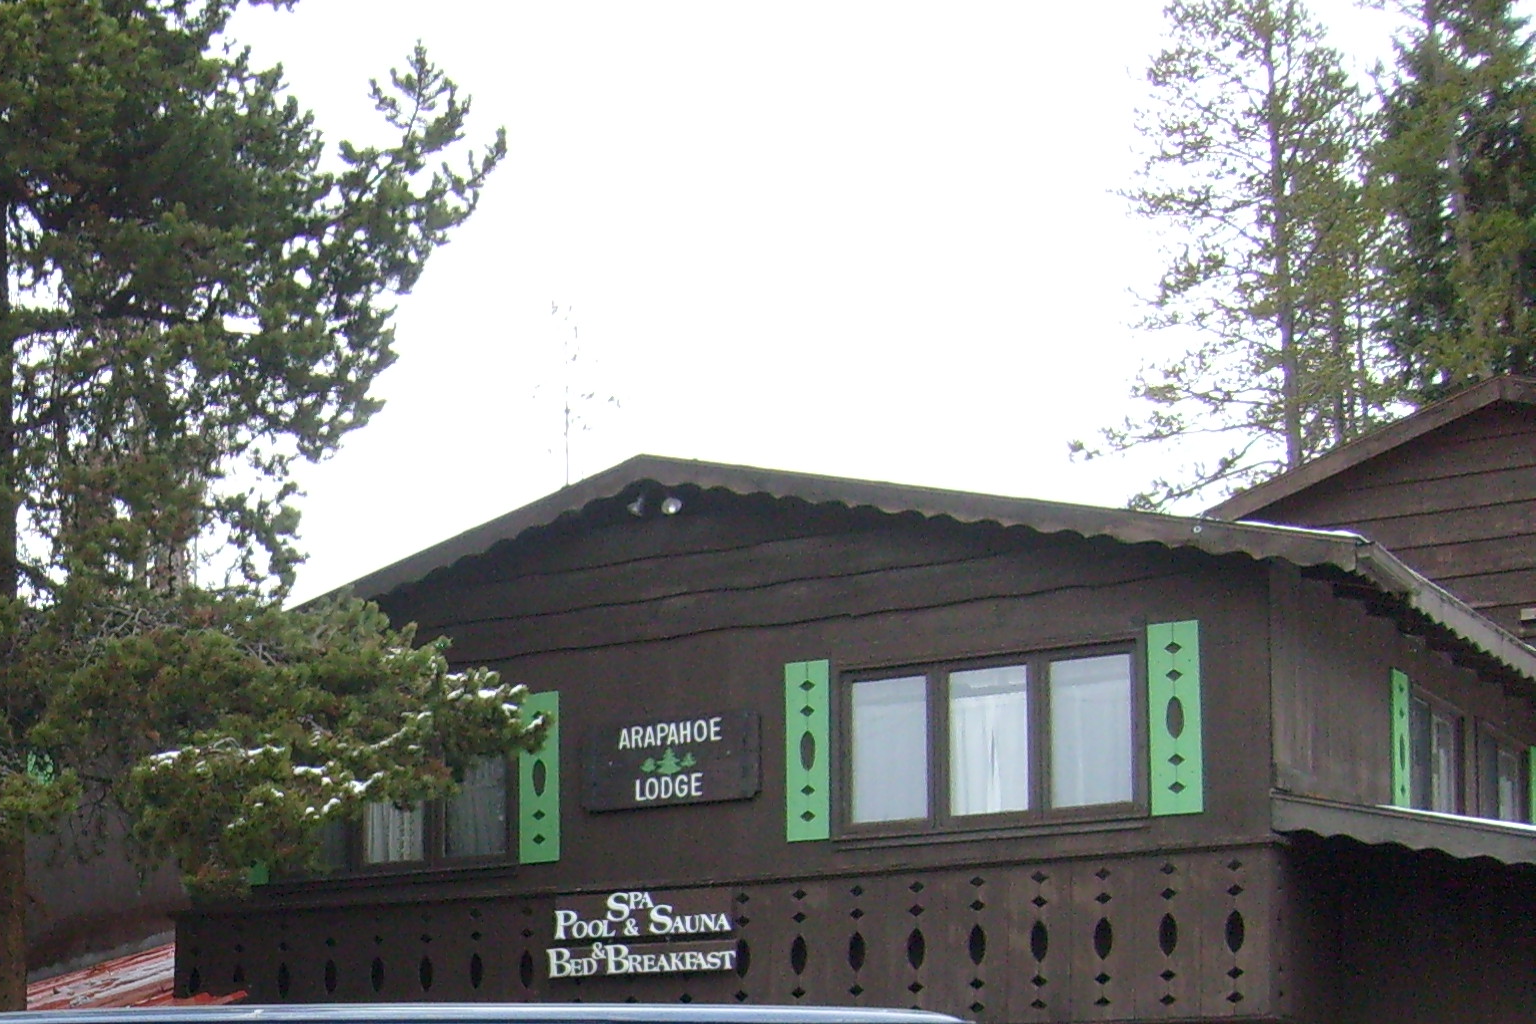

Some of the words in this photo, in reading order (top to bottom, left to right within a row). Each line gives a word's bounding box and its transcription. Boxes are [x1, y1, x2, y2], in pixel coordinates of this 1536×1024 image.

[618, 717, 722, 750] ARAPAHOE
[635, 772, 703, 801] LODGE
[623, 918, 639, 936] &
[591, 942, 606, 960] &
